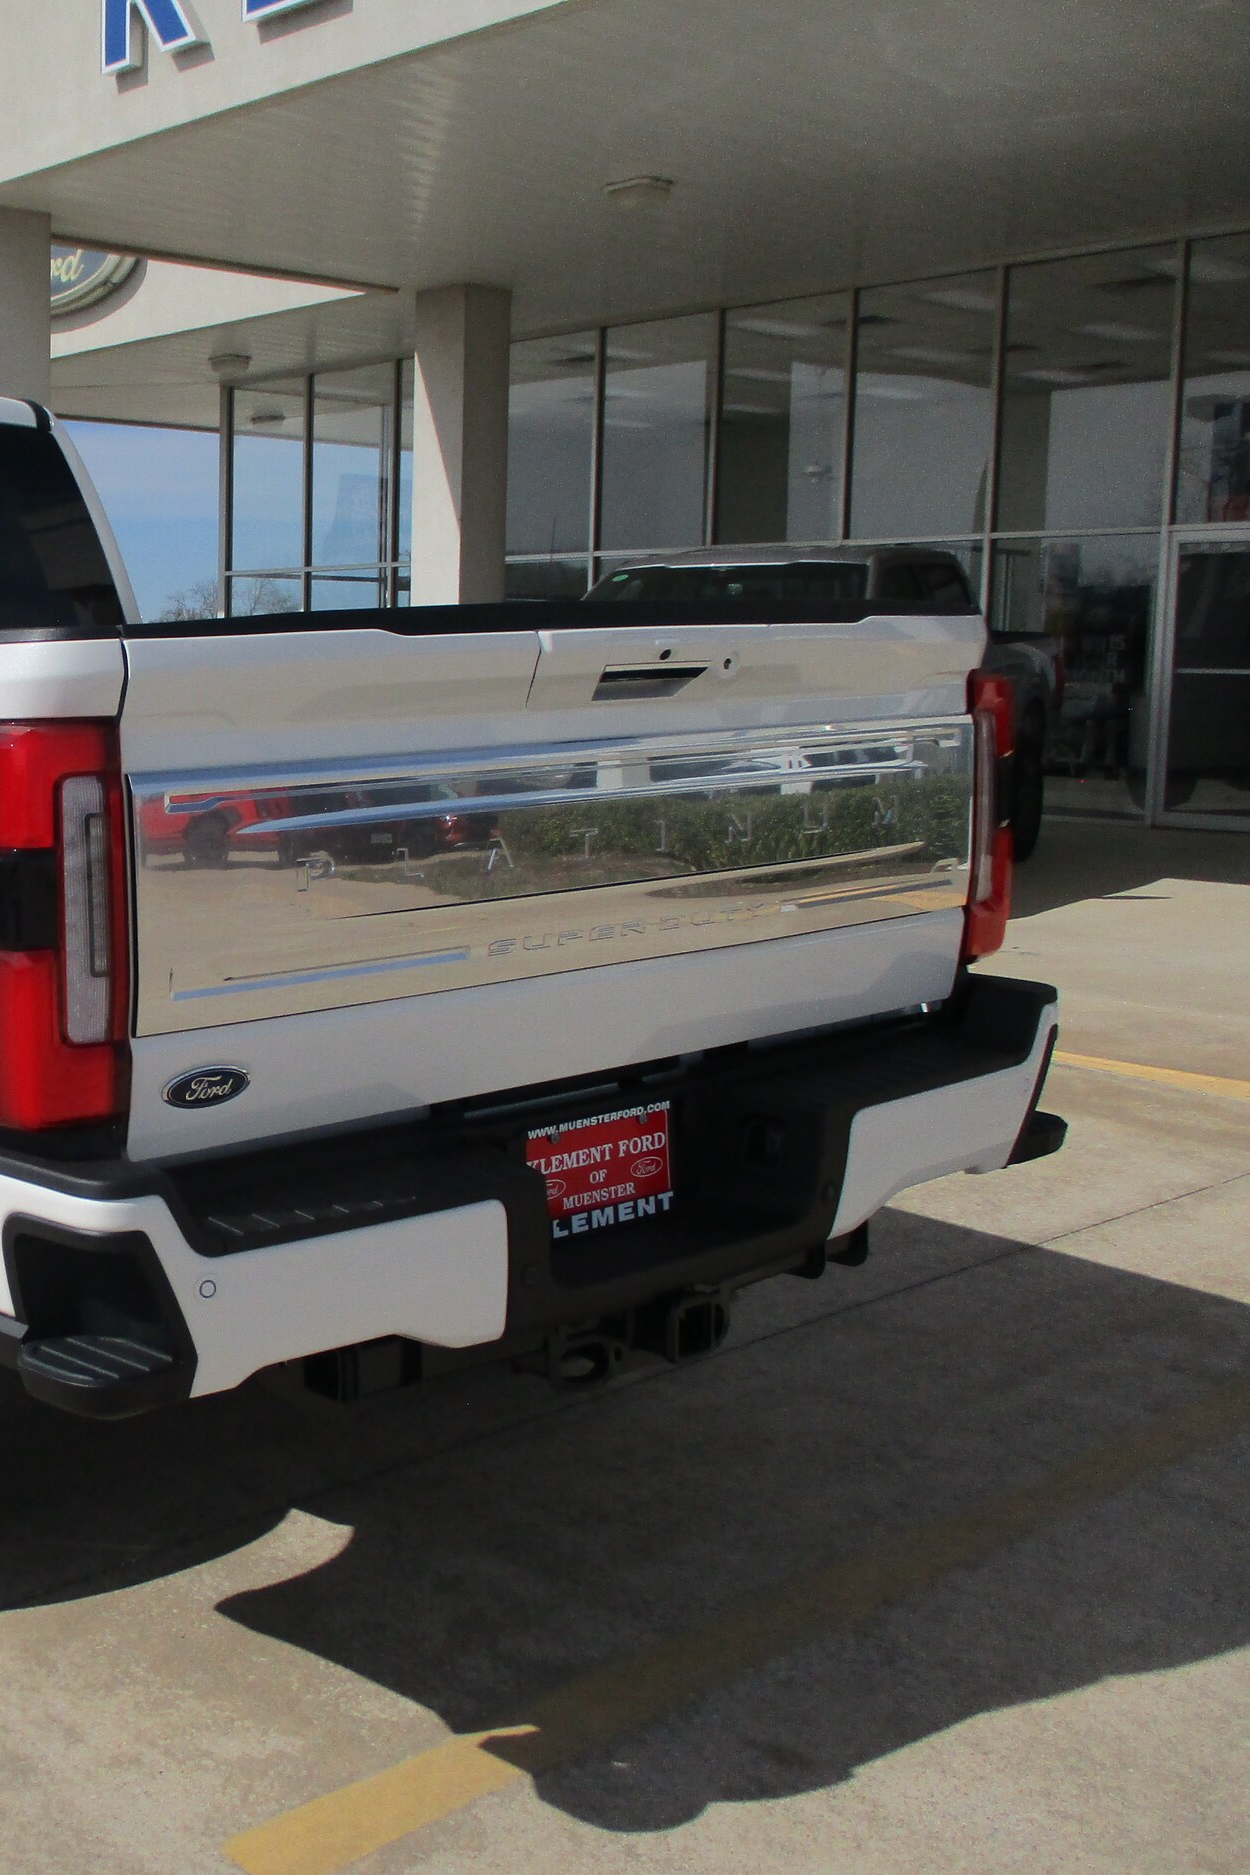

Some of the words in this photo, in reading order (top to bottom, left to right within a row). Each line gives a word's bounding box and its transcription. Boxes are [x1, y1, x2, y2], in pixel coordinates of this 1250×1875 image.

[296, 794, 899, 892] PLATINUM
[488, 919, 645, 957] SUPER
[185, 1074, 233, 1101] Ford
[527, 1100, 670, 1140] WWW.MUENSTERFORD.COM
[618, 1131, 666, 1158] FORD
[589, 1168, 608, 1184] OF
[562, 1182, 636, 1211] MUENSTER
[552, 1191, 674, 1239] LEMENT
